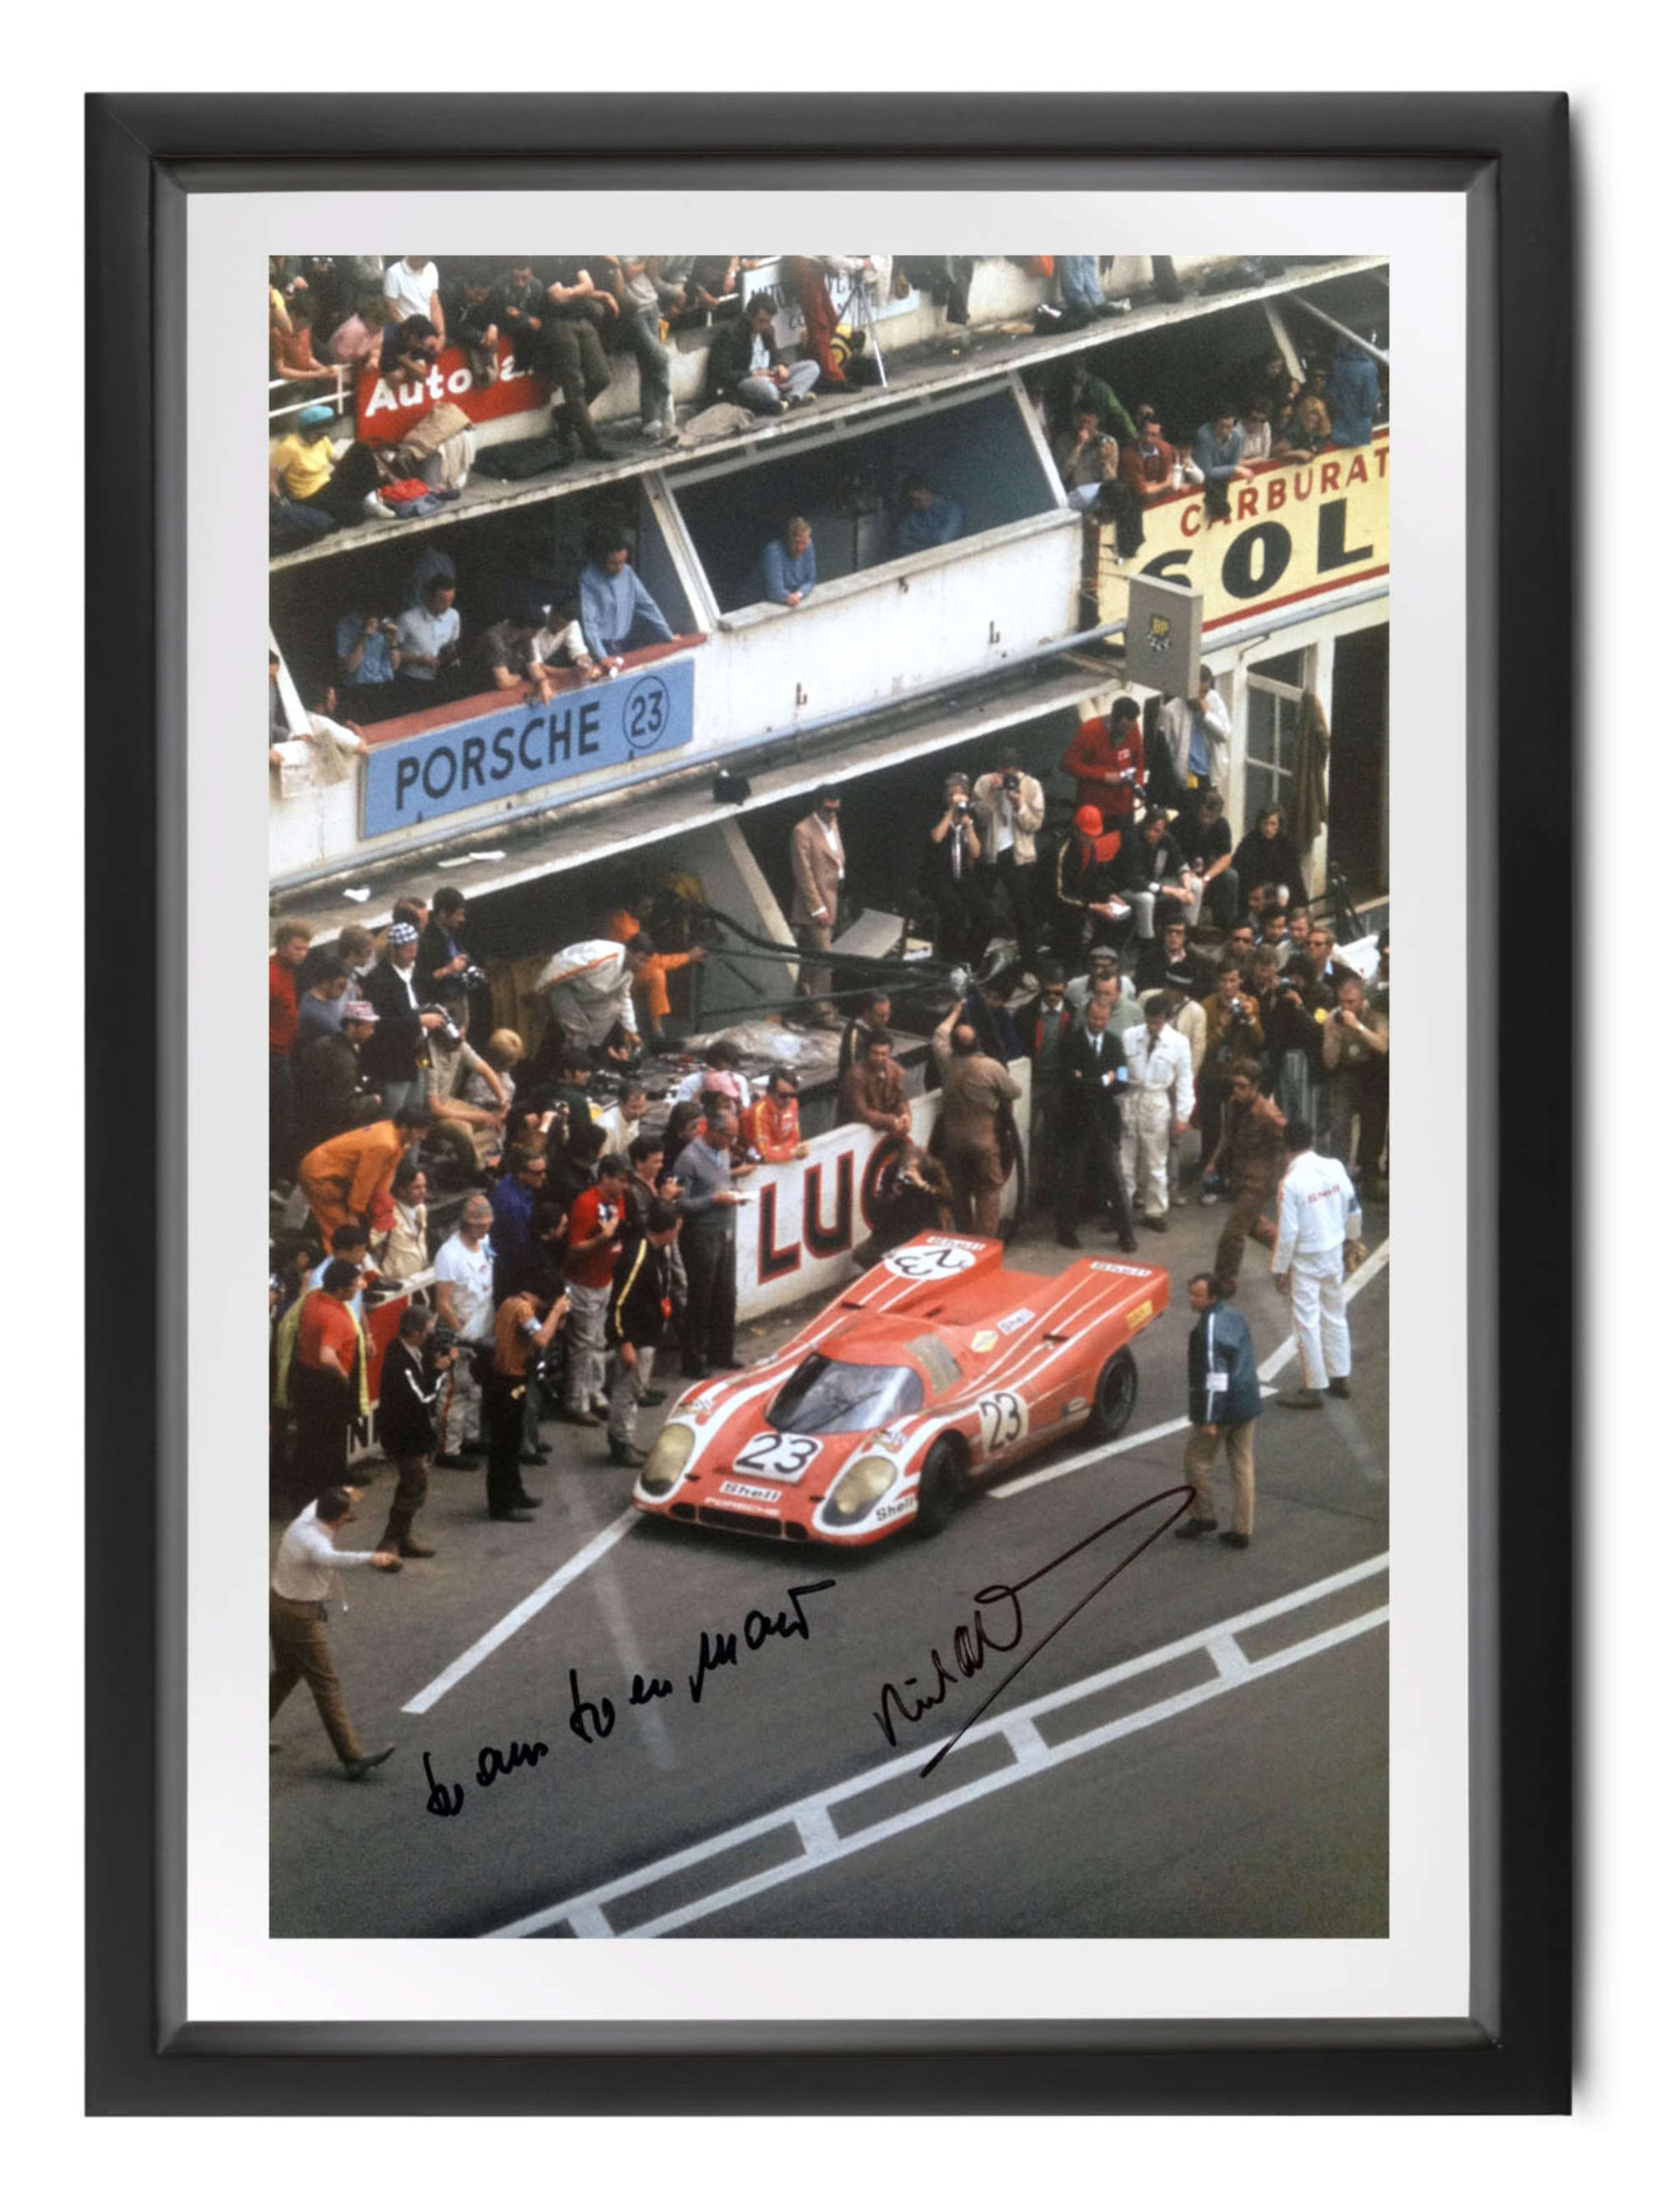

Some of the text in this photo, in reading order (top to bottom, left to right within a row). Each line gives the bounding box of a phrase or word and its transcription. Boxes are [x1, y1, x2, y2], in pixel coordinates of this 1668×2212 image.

[1180, 447, 1389, 537] CRBURAT
[1153, 617, 1168, 635] BP
[395, 690, 664, 811] PORSCHE 23
[979, 1392, 1022, 1454] 23
[735, 1433, 819, 1474] 23
[722, 1482, 778, 1500] Shell
[875, 1496, 914, 1521] Shell
